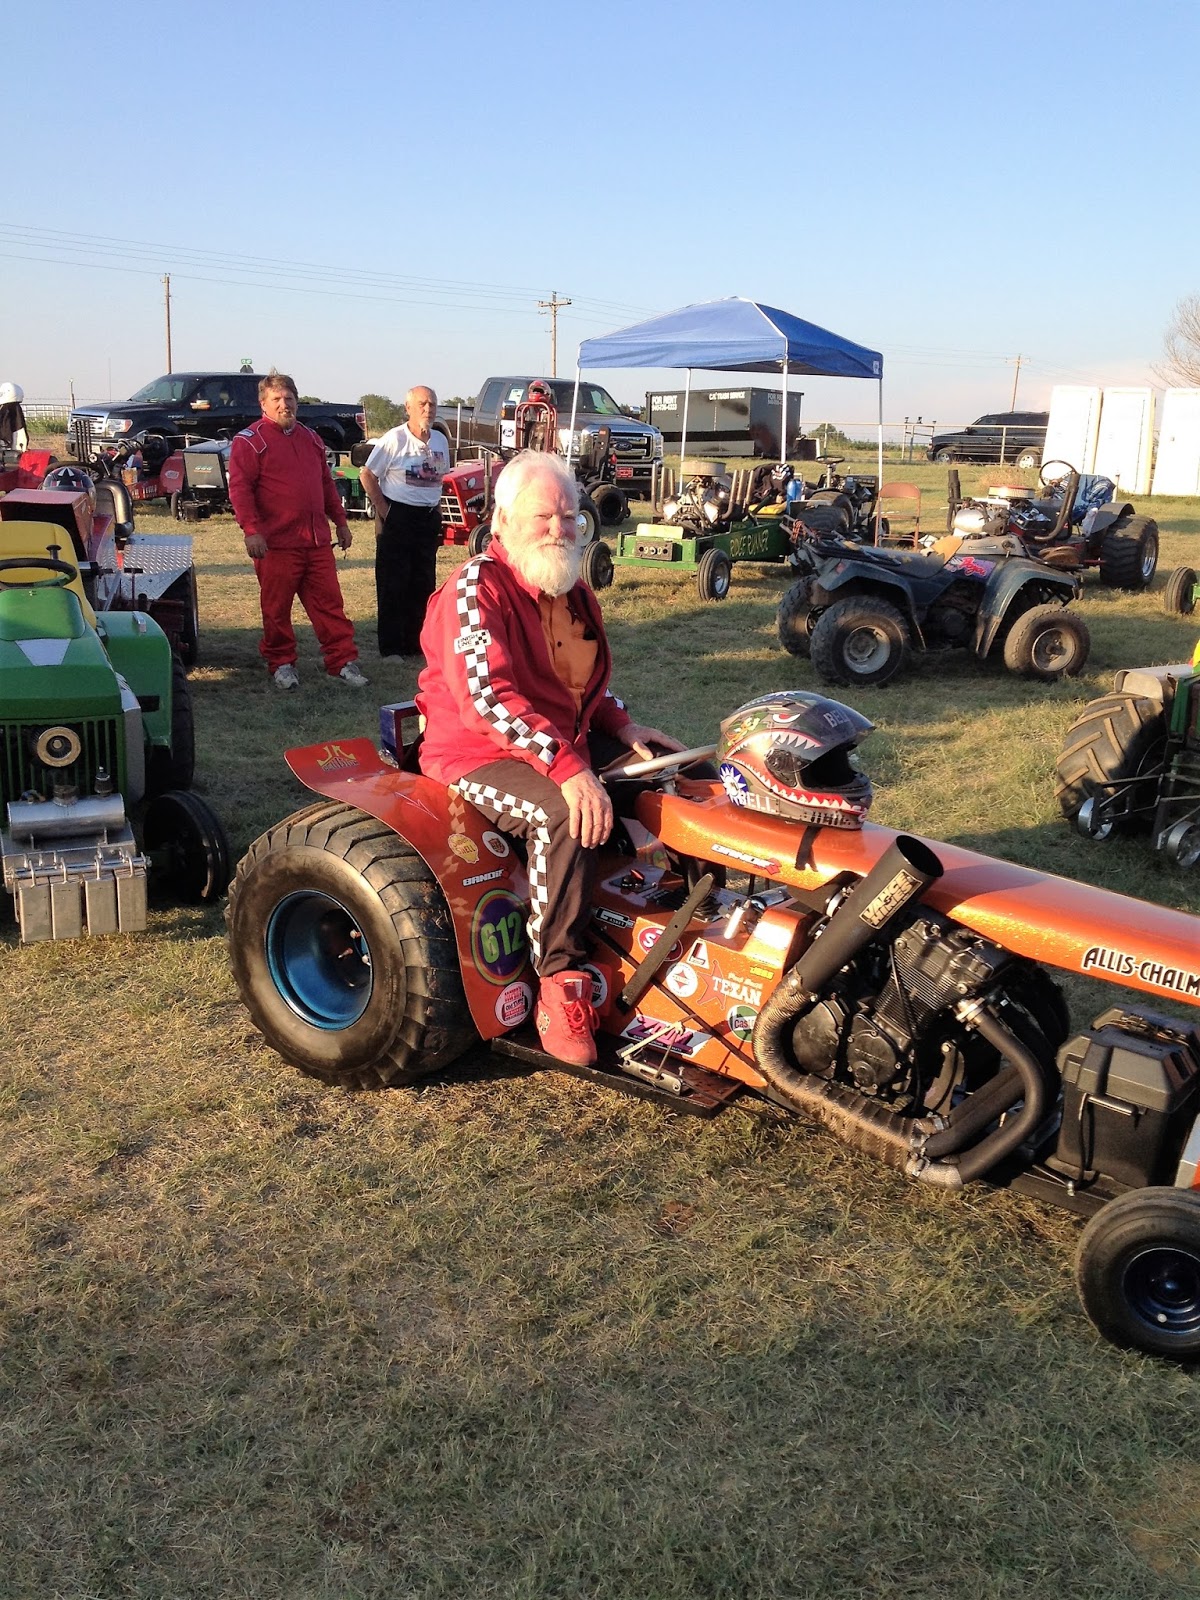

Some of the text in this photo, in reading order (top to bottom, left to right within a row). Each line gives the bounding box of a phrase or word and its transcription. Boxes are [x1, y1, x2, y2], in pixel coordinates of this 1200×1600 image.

[652, 395, 678, 405] FOR RENT
[738, 791, 777, 813] BELL
[862, 872, 907, 920] VANCE
[481, 911, 525, 964] 612
[712, 976, 763, 1007] TEXAN
